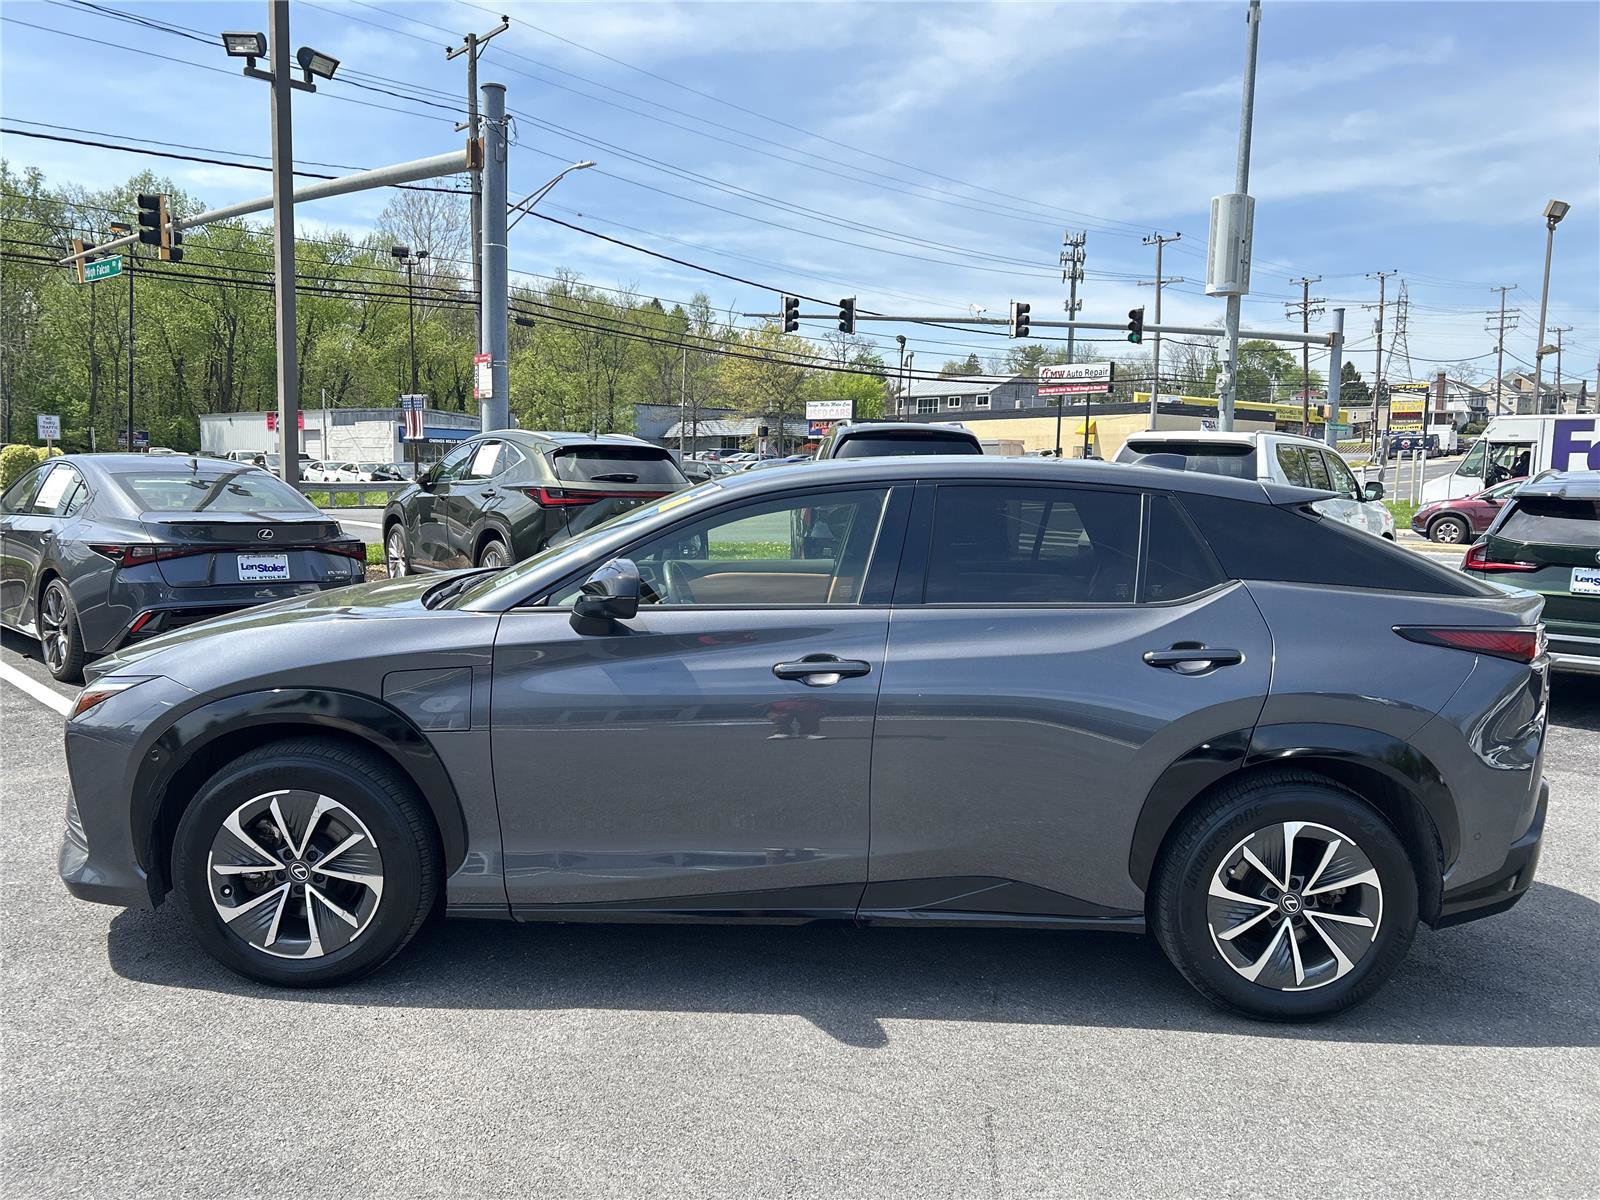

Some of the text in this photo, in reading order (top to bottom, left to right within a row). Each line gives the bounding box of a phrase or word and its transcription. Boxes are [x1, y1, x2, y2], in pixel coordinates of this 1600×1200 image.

[1066, 369, 1083, 378] Auto
[1084, 367, 1109, 378] Repair
[808, 408, 850, 418] USED CARS
[1575, 575, 1600, 586] LenS
